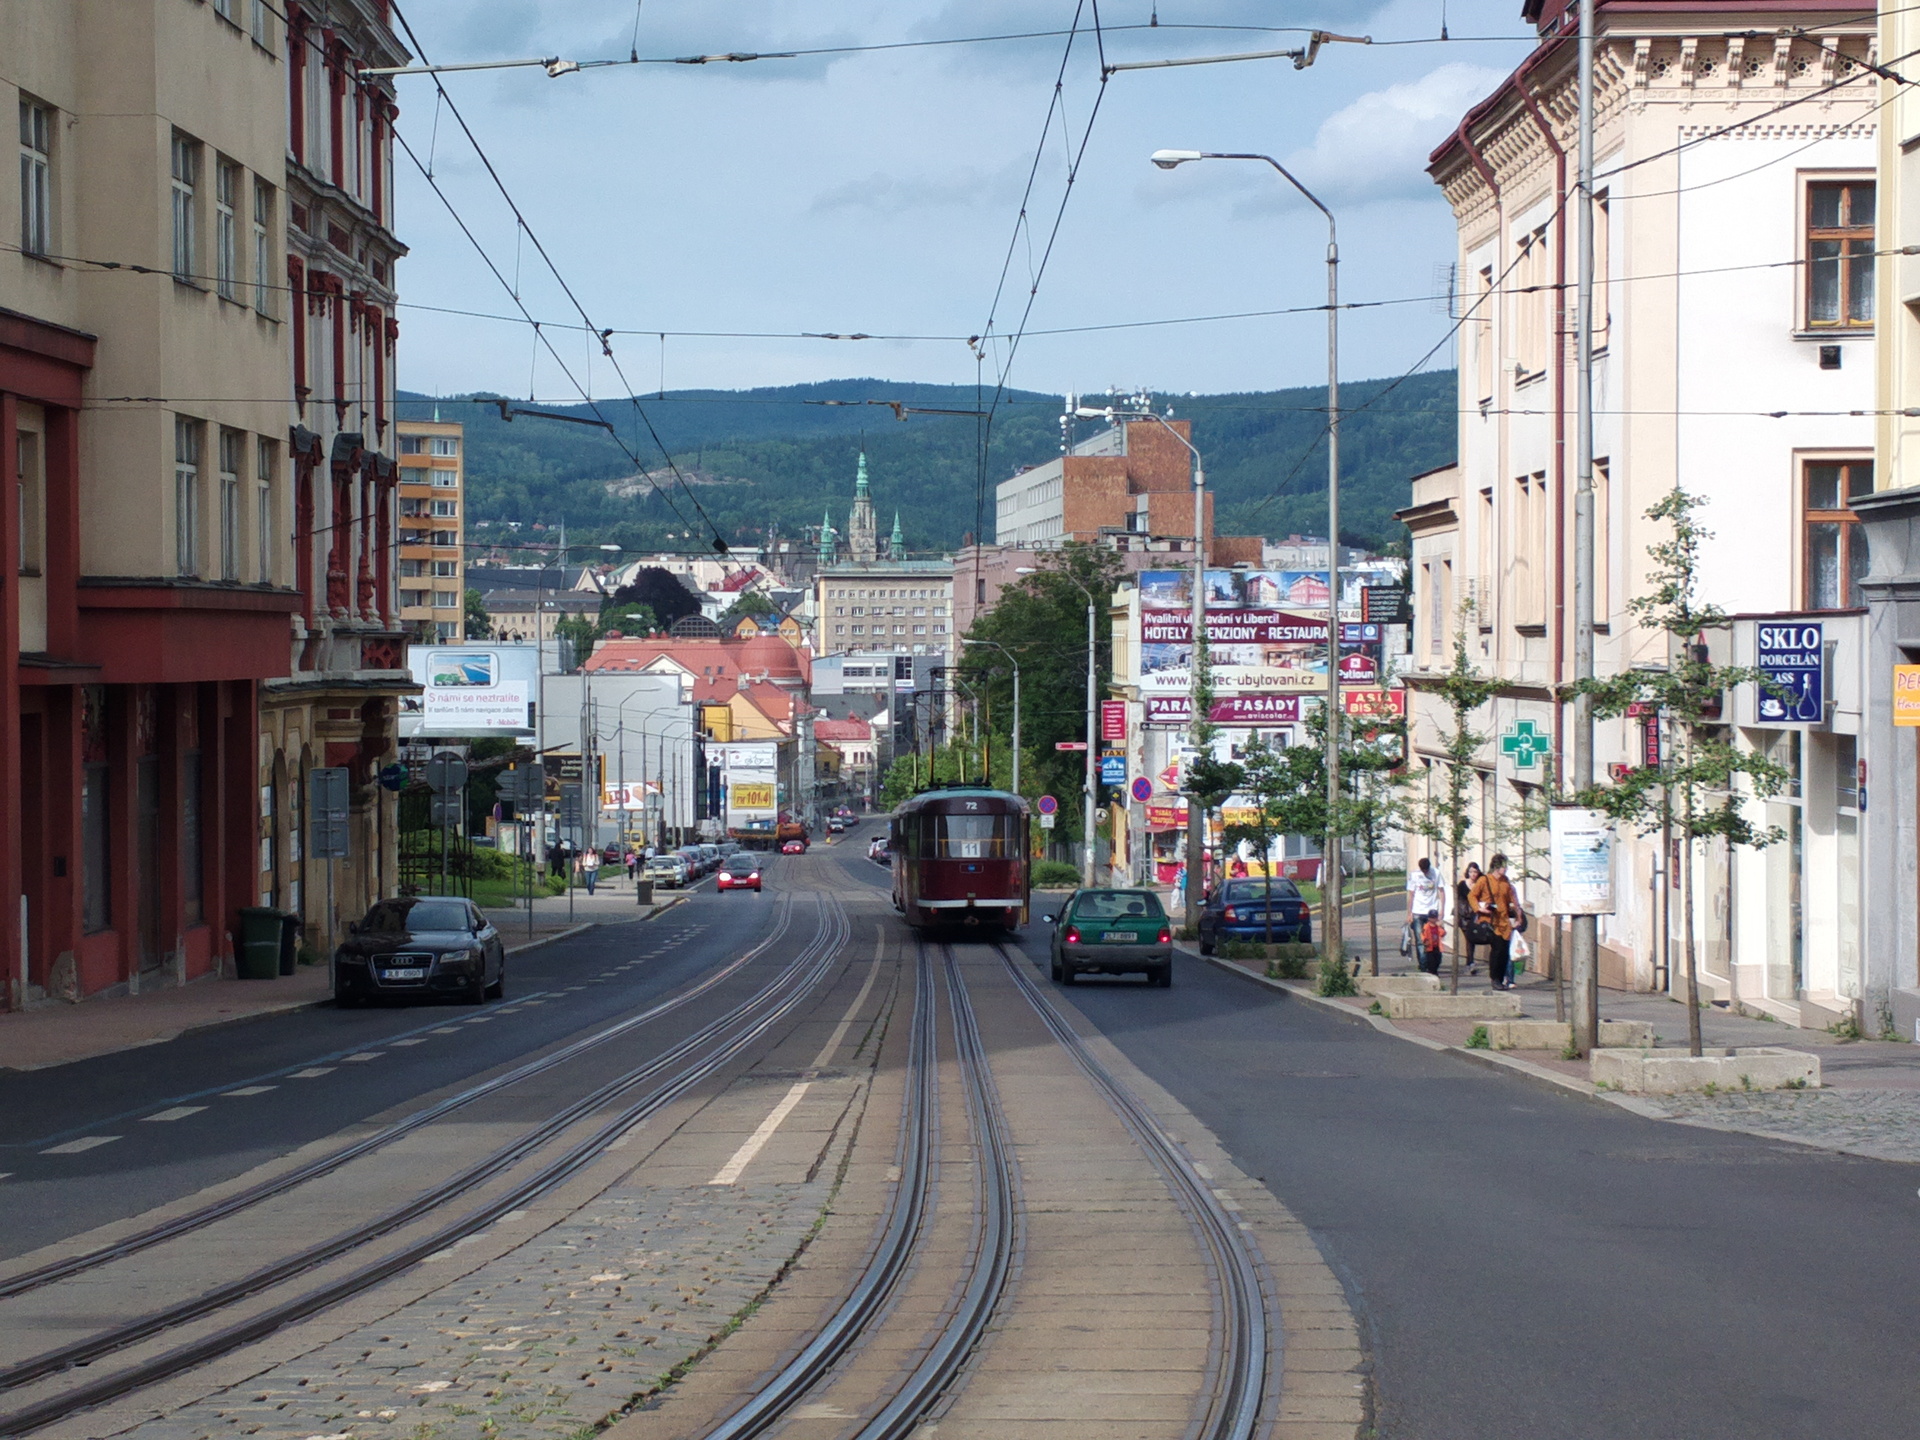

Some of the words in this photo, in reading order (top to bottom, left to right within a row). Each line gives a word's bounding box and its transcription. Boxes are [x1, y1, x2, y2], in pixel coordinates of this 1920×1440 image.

[1016, 540, 1055, 550] HOT
[1184, 613, 1233, 624] uování
[1235, 616, 1241, 624] v
[1312, 611, 1330, 619] +42
[1144, 626, 1188, 640] HOTELY
[1268, 626, 1344, 640] RESTAURAE
[1760, 627, 1819, 649] SKLO
[1760, 651, 1820, 666] PORCELÁN
[1155, 672, 1315, 688] www.rec-ubytovani.cz
[429, 693, 436, 702] S
[437, 692, 461, 702] námi
[463, 694, 474, 702] se
[1355, 692, 1393, 703] ASIA
[1150, 697, 1192, 712] PARÁ
[1233, 696, 1296, 711] FASÁDY
[1350, 703, 1399, 713] BISRO
[965, 802, 978, 810] 72
[964, 843, 978, 855] 11
